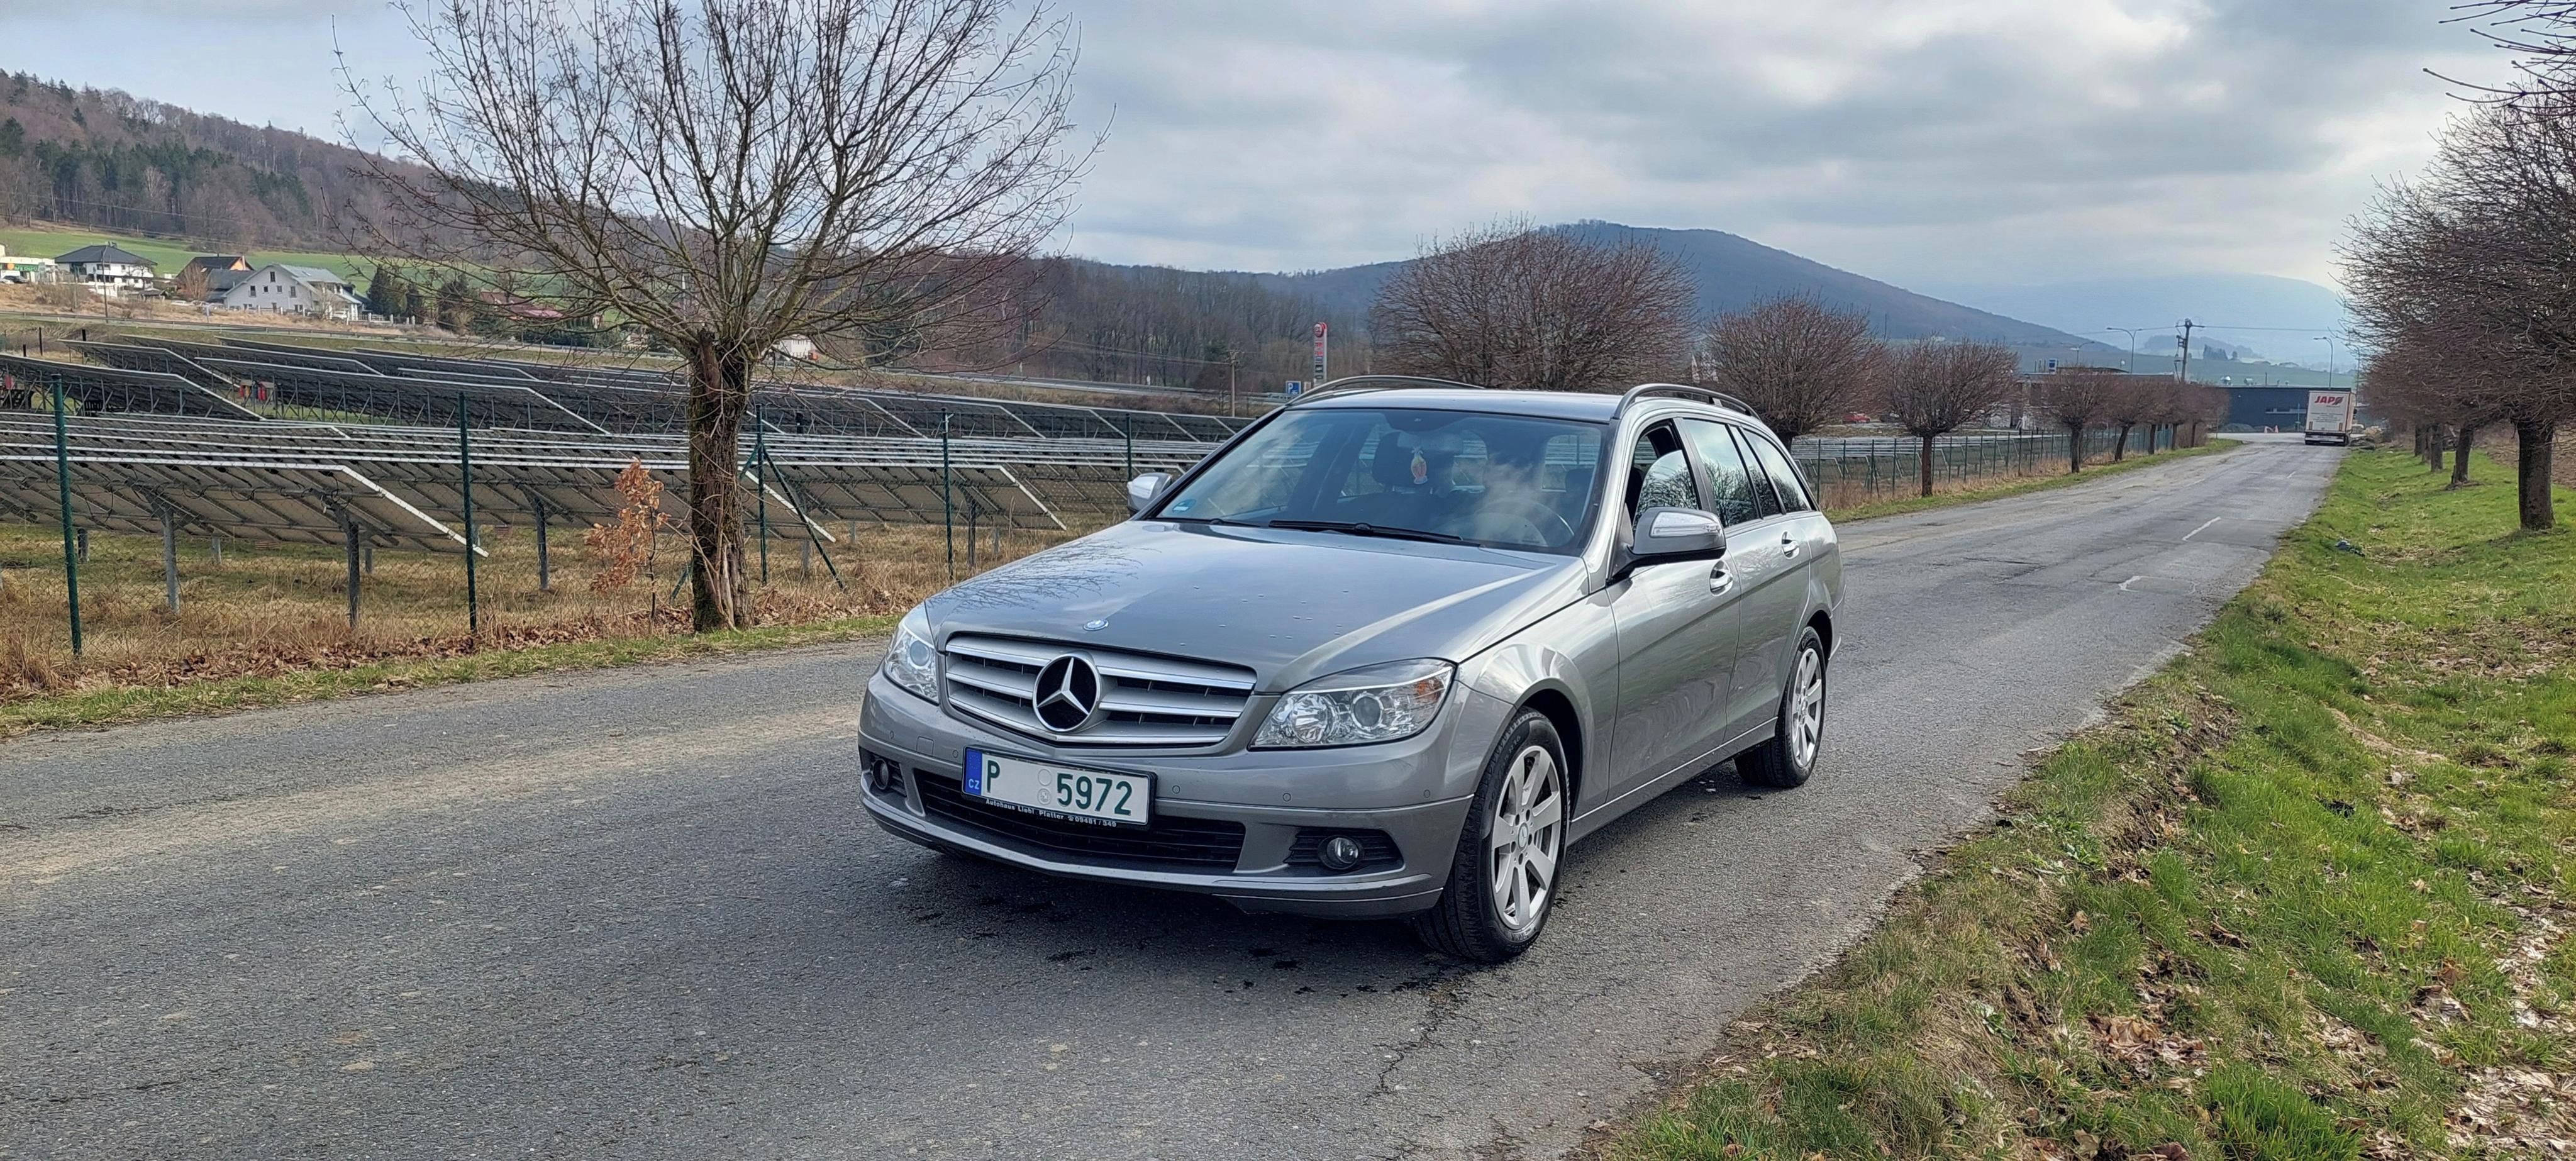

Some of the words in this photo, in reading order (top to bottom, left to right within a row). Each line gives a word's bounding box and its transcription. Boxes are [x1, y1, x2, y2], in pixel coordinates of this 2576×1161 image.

[968, 778, 980, 790] CZ
[986, 760, 1001, 794] P
[1057, 773, 1133, 816] 5972
[985, 799, 1016, 811] Autohaus
[1018, 806, 1035, 814] Liebl
